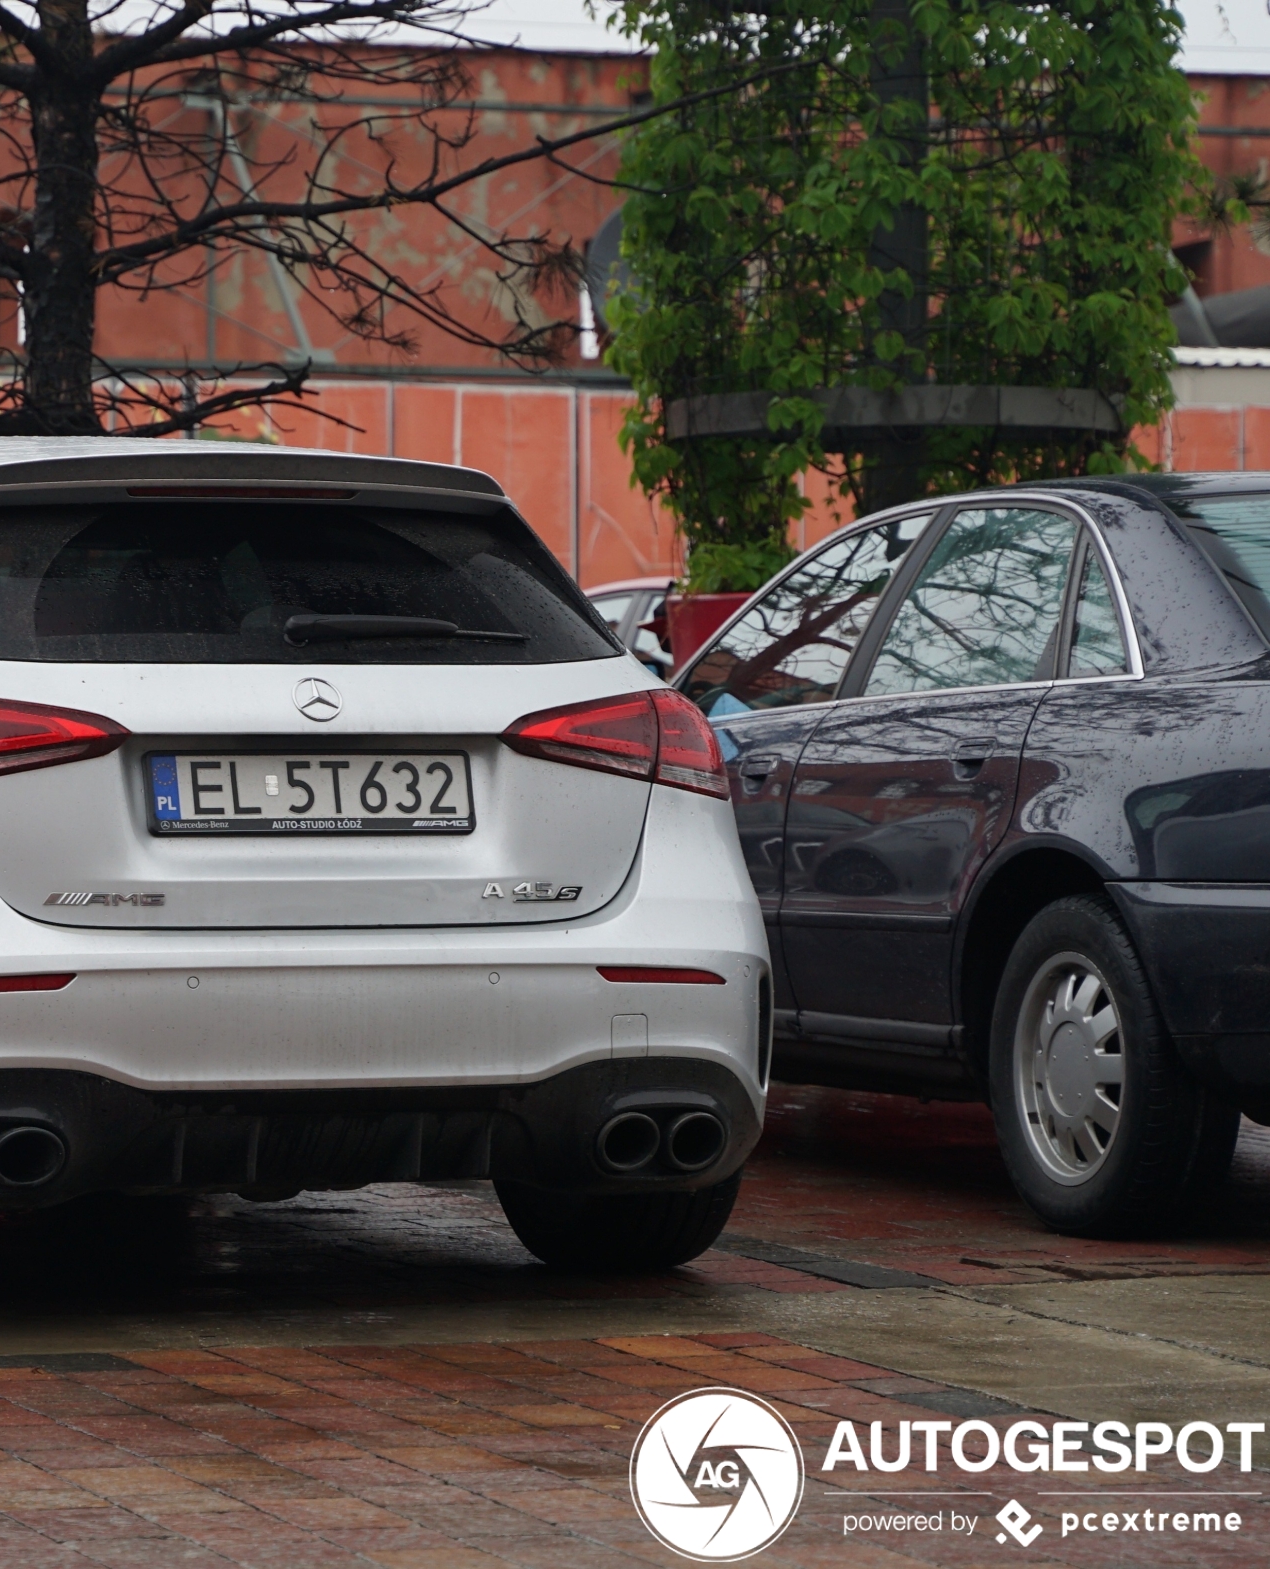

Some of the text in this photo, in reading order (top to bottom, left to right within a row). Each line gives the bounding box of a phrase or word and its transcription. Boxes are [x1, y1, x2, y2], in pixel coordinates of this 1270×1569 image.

[190, 760, 458, 815] EL 5T632
[157, 796, 177, 811] PL
[172, 820, 230, 829] Mercedes-Benz
[271, 818, 363, 830] AUTO-STUDIO ŁÓDŹ
[81, 892, 166, 906] AMG
